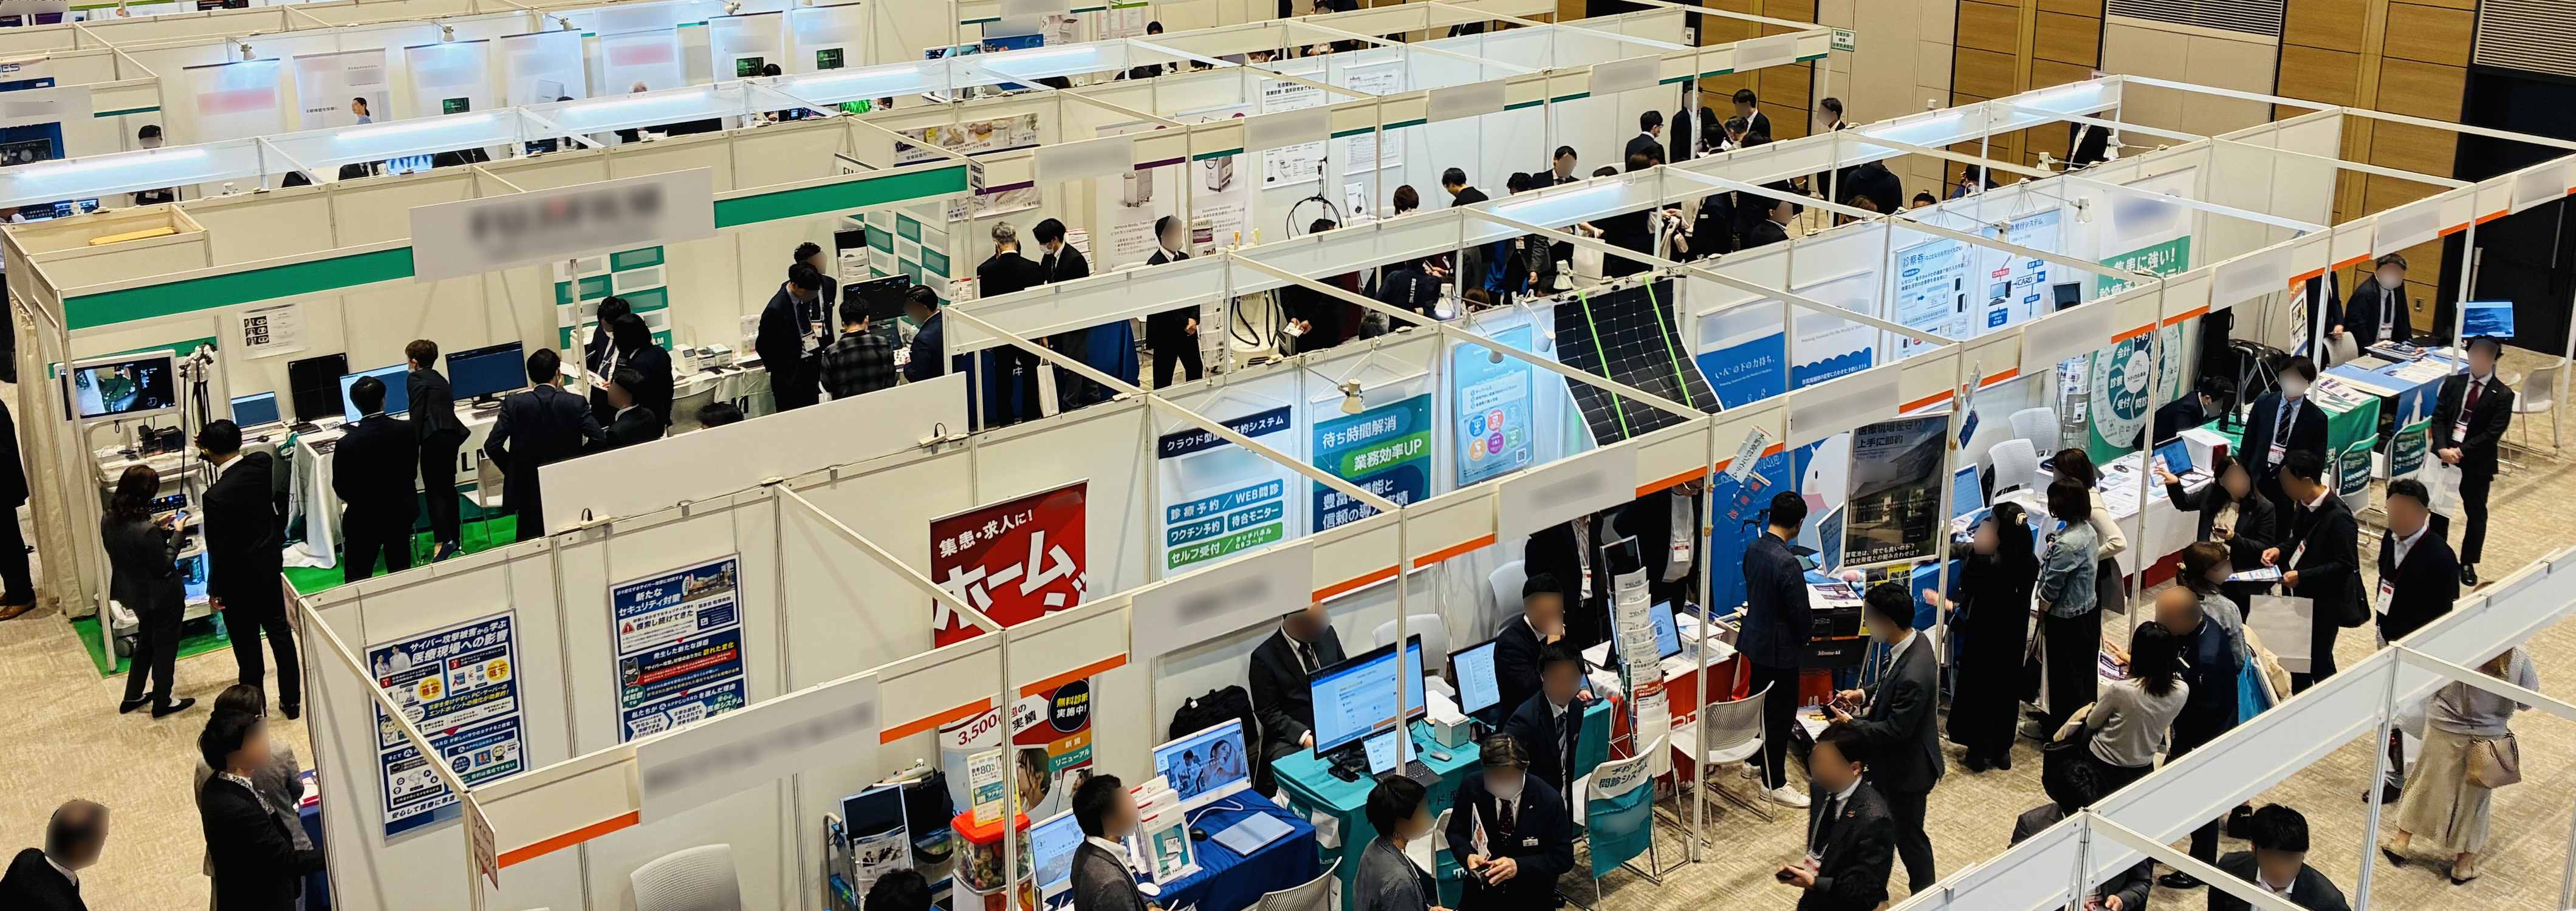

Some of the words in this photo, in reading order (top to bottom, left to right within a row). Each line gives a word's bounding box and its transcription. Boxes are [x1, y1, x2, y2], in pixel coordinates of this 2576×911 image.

[2117, 346, 2131, 359] 会計
[2110, 375, 2123, 389] 診察
[2117, 396, 2131, 410] 受付
[1167, 415, 1284, 451] クラウド型診予約システム
[1323, 415, 1397, 449] 待ち時間解消
[1857, 435, 1903, 449] 上手に節約
[1354, 438, 1422, 471] 業務効率UP
[1231, 508, 1279, 528] 待合モニター
[1171, 520, 1221, 542] ワクチン予約
[1236, 528, 1272, 542] タッチパネル
[618, 593, 681, 616] セキュリティ対策
[635, 588, 663, 602] 新たな
[410, 620, 507, 652] サイバー攻撃被害から学ぶ
[412, 629, 509, 666] 医療現場への影響
[1057, 691, 1089, 708] 無料診断
[1012, 710, 1037, 732] 実績
[1065, 737, 1081, 748] 新規
[1055, 748, 1090, 766] リニューアル
